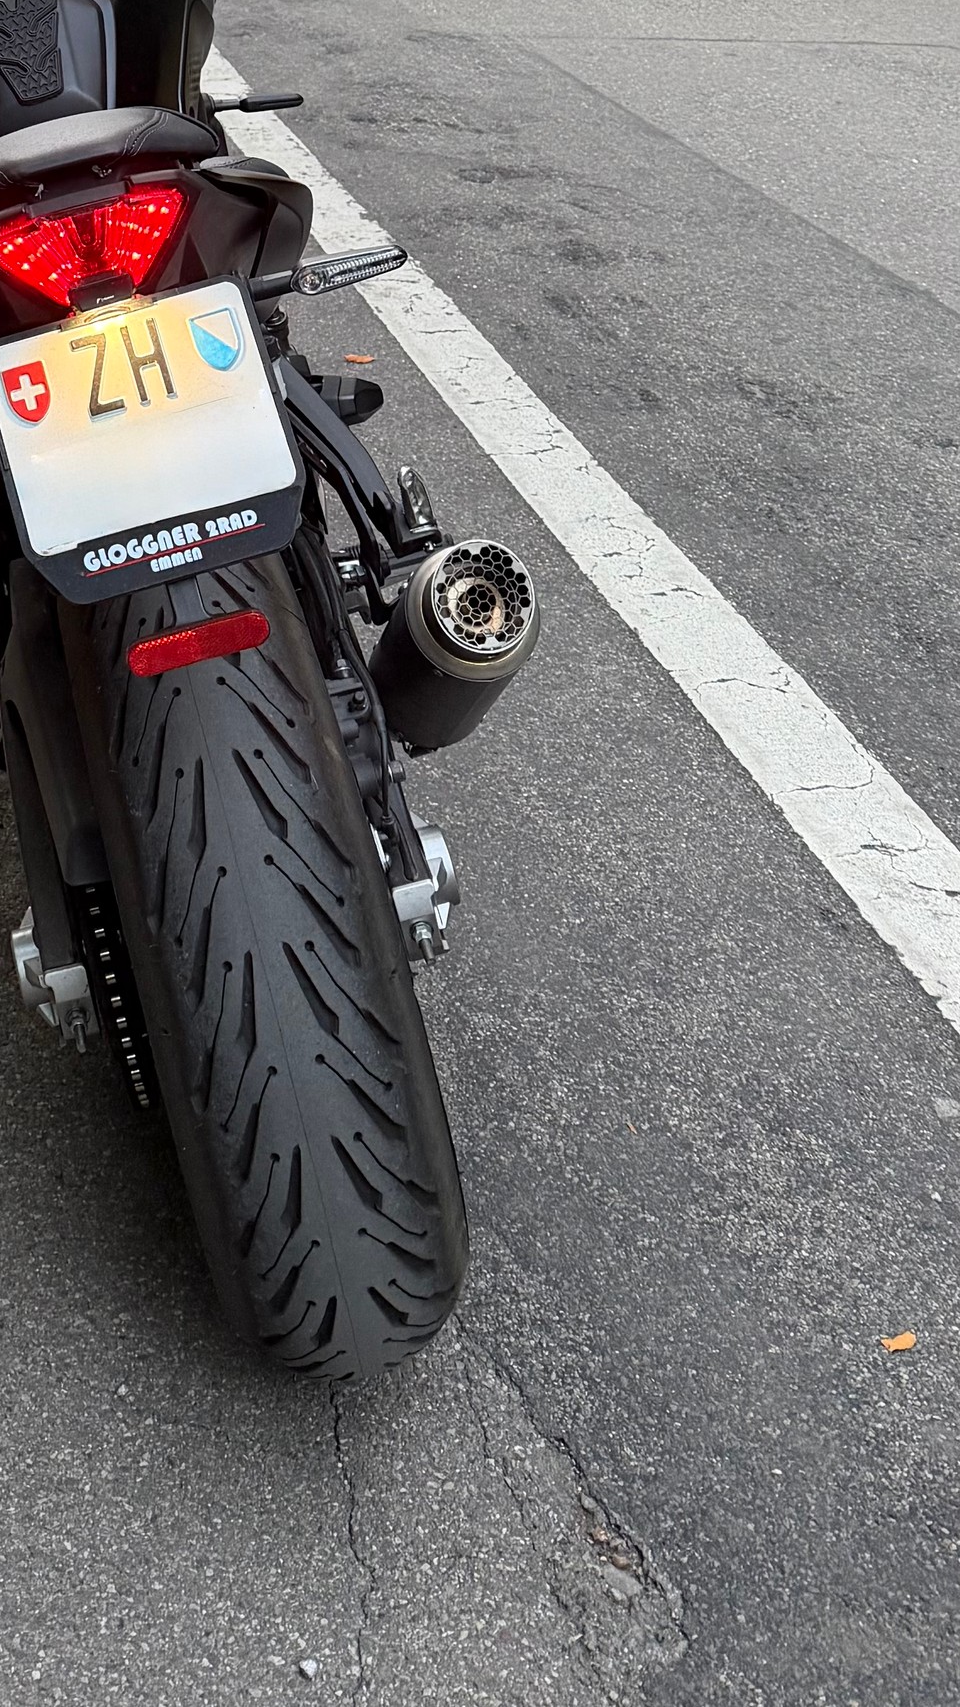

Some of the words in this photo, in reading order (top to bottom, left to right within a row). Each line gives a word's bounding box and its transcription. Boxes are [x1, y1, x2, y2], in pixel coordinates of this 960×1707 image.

[69, 317, 179, 421] ZH
[83, 522, 203, 572] GLOGGNER
[205, 509, 258, 539] 2RAD
[149, 546, 203, 573] EMMEN
